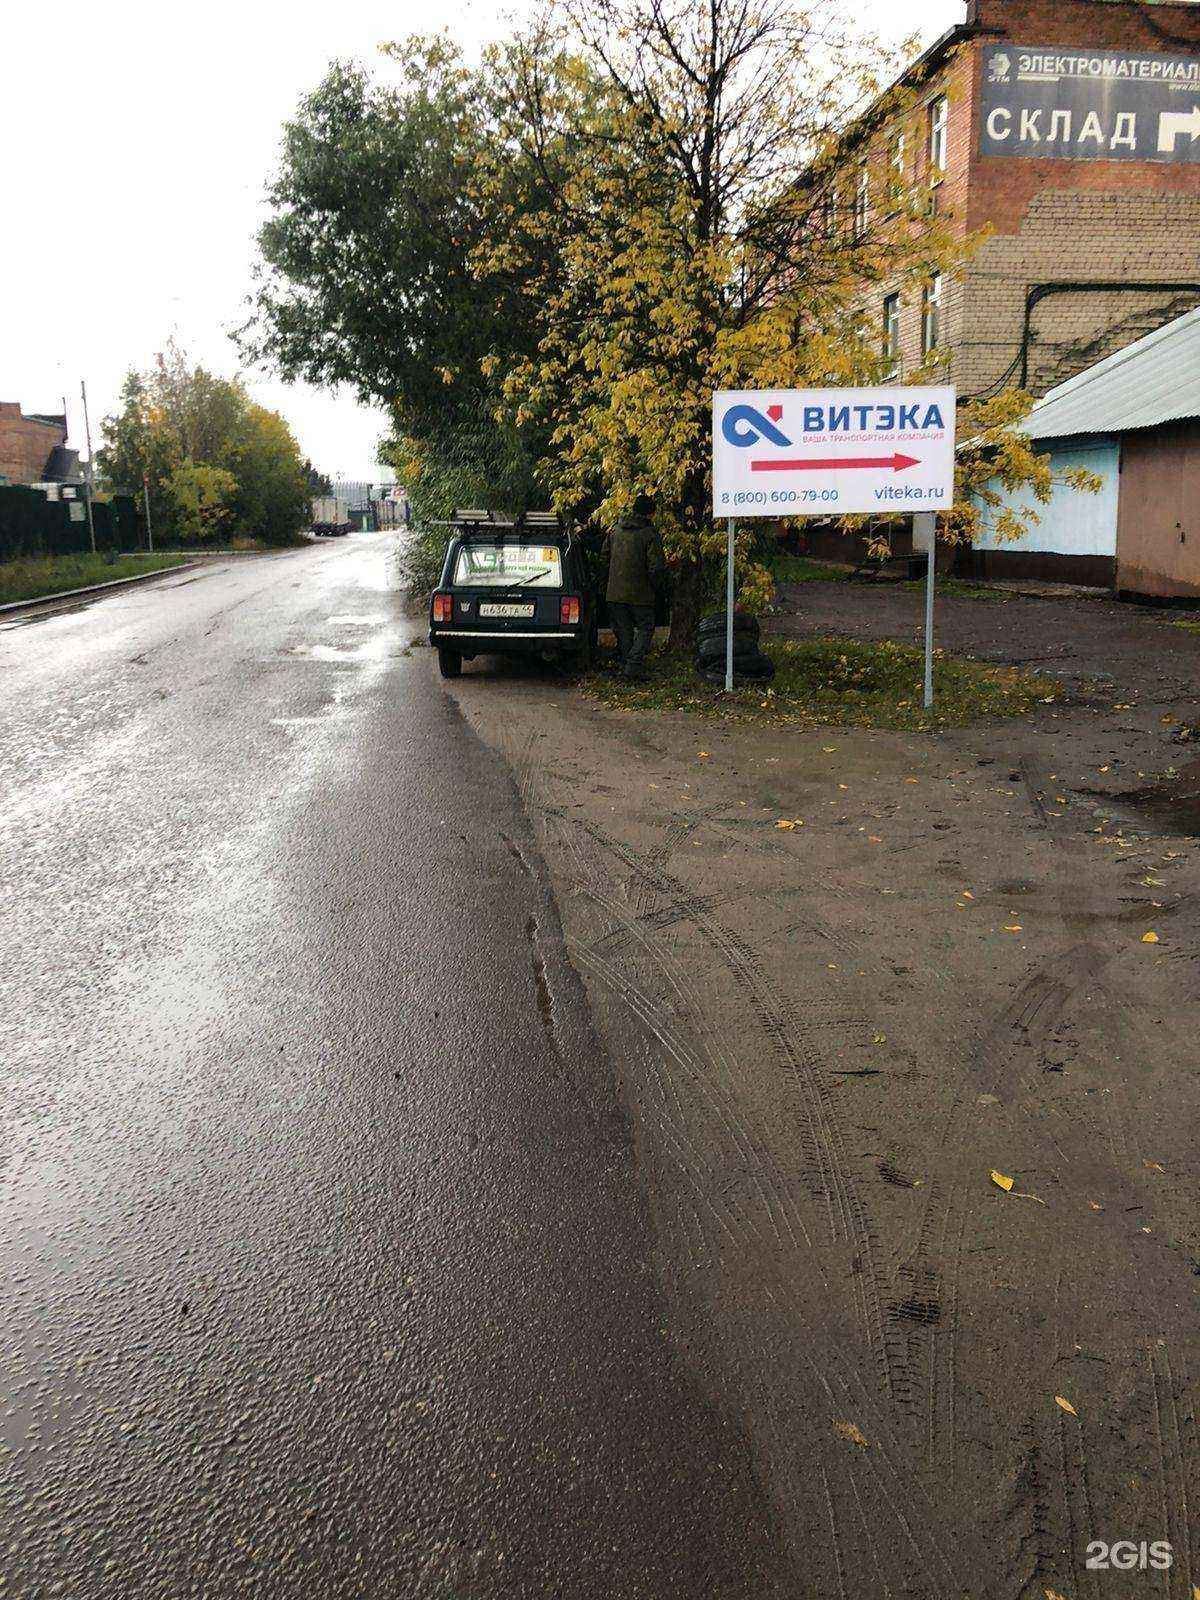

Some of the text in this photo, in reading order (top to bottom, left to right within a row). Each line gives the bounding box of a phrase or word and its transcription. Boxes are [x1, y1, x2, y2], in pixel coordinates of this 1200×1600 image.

[986, 107, 1137, 150] СКЛАД
[803, 404, 945, 432] ВИТЭКА
[803, 432, 944, 443] ВАША ТРАНСПОРТНАЯ КОМПАНИЯ
[721, 489, 839, 506] 8 (800) 600-79-00
[874, 485, 944, 501] viteka.ru
